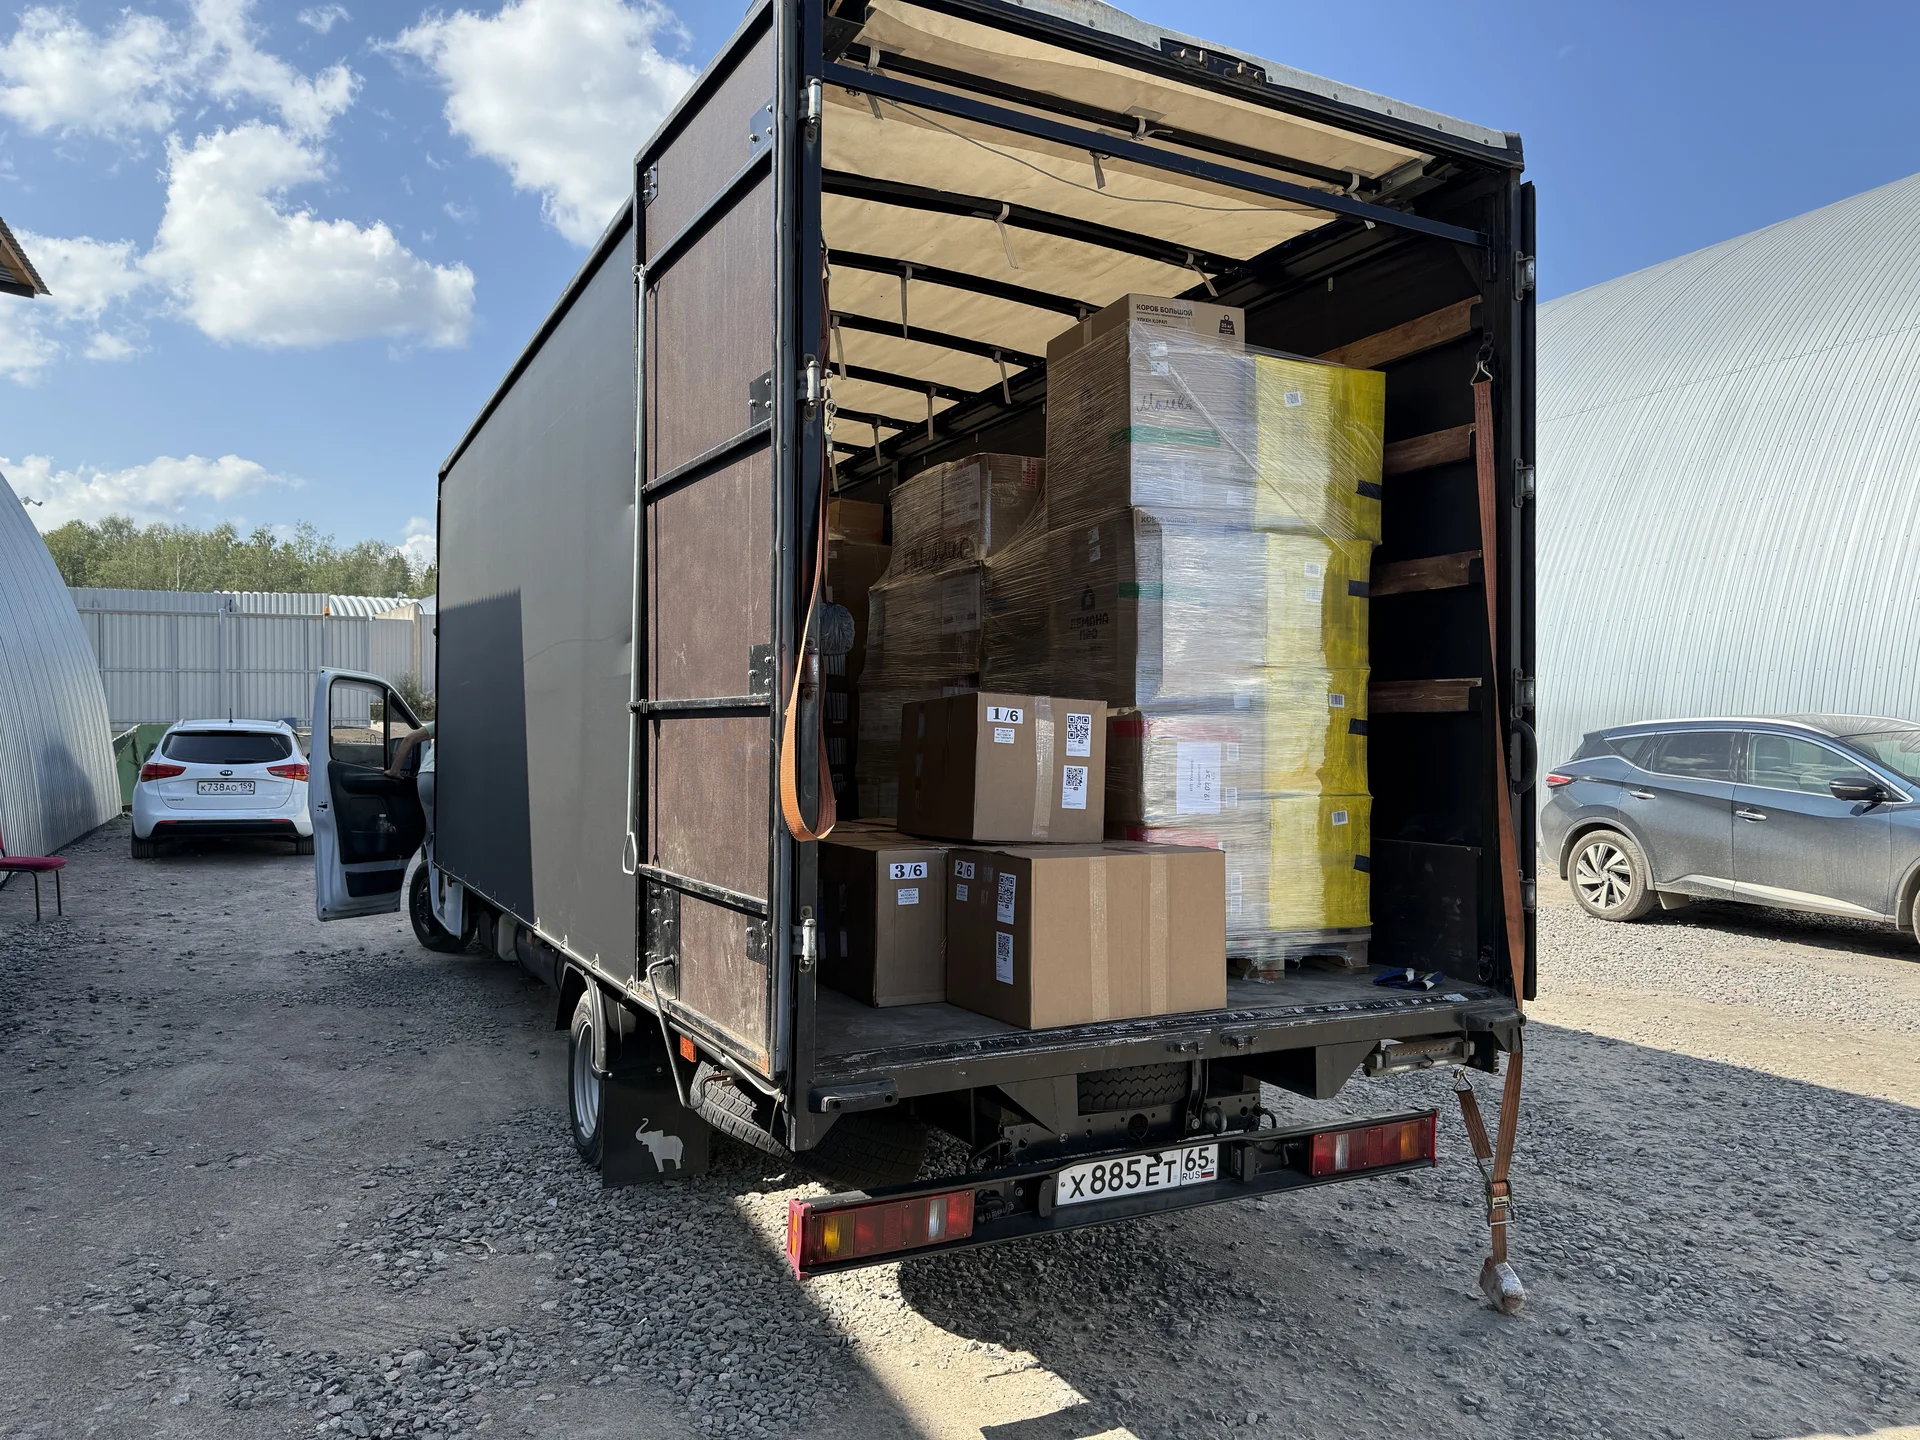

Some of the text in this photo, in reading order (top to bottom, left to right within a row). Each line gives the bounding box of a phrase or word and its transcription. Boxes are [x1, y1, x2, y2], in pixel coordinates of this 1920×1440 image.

[1136, 303, 1159, 312] КОРОБ
[1160, 306, 1193, 316] БОЛЬШОЙ
[1184, 1147, 1209, 1172] 65
[1182, 1171, 1200, 1181] RUS
